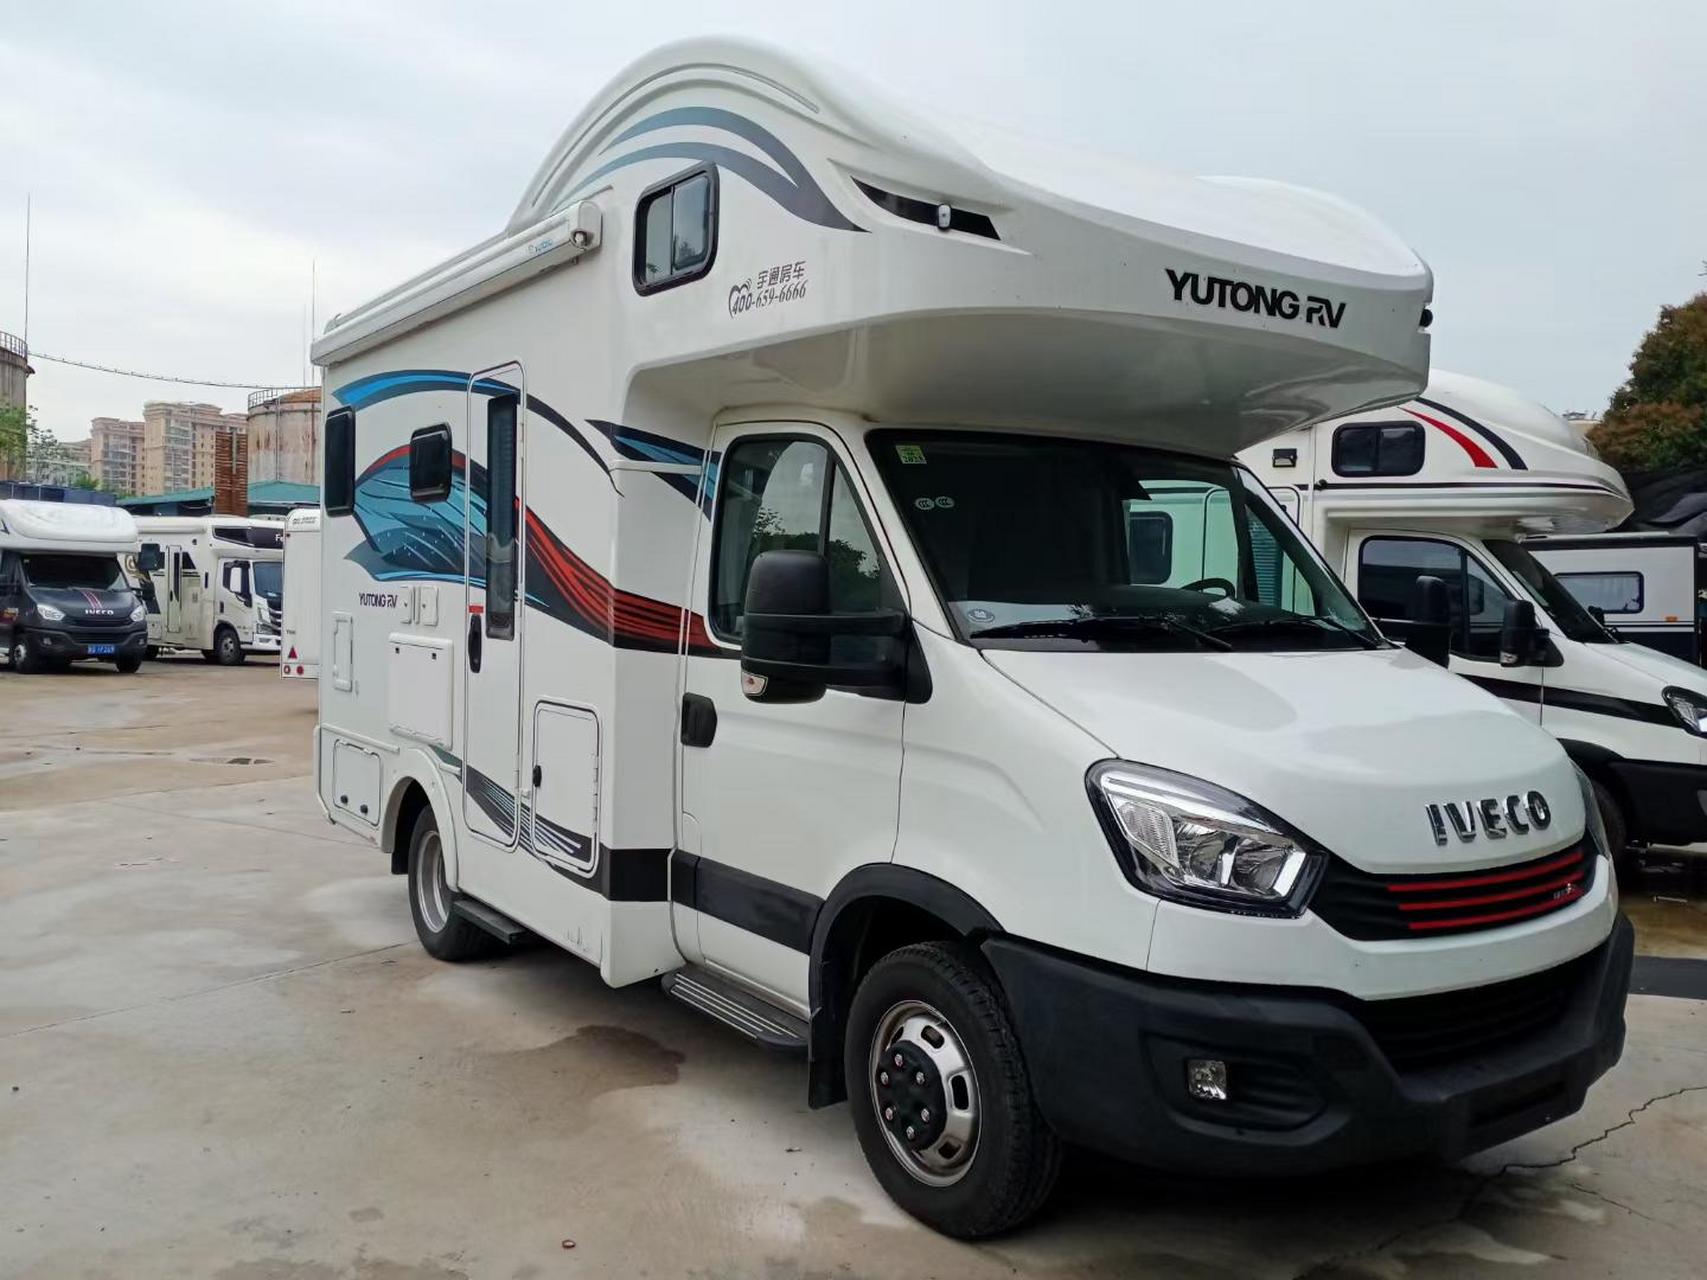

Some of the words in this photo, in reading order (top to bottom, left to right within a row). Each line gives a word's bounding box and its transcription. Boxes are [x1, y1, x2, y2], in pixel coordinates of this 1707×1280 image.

[757, 260, 806, 289] 宇通房车
[732, 279, 808, 315] 400-659-6666
[1165, 268, 1300, 320] YUTONG
[1306, 295, 1347, 329] RV
[358, 592, 386, 608] YUTONG
[1425, 790, 1551, 846] IVECO
